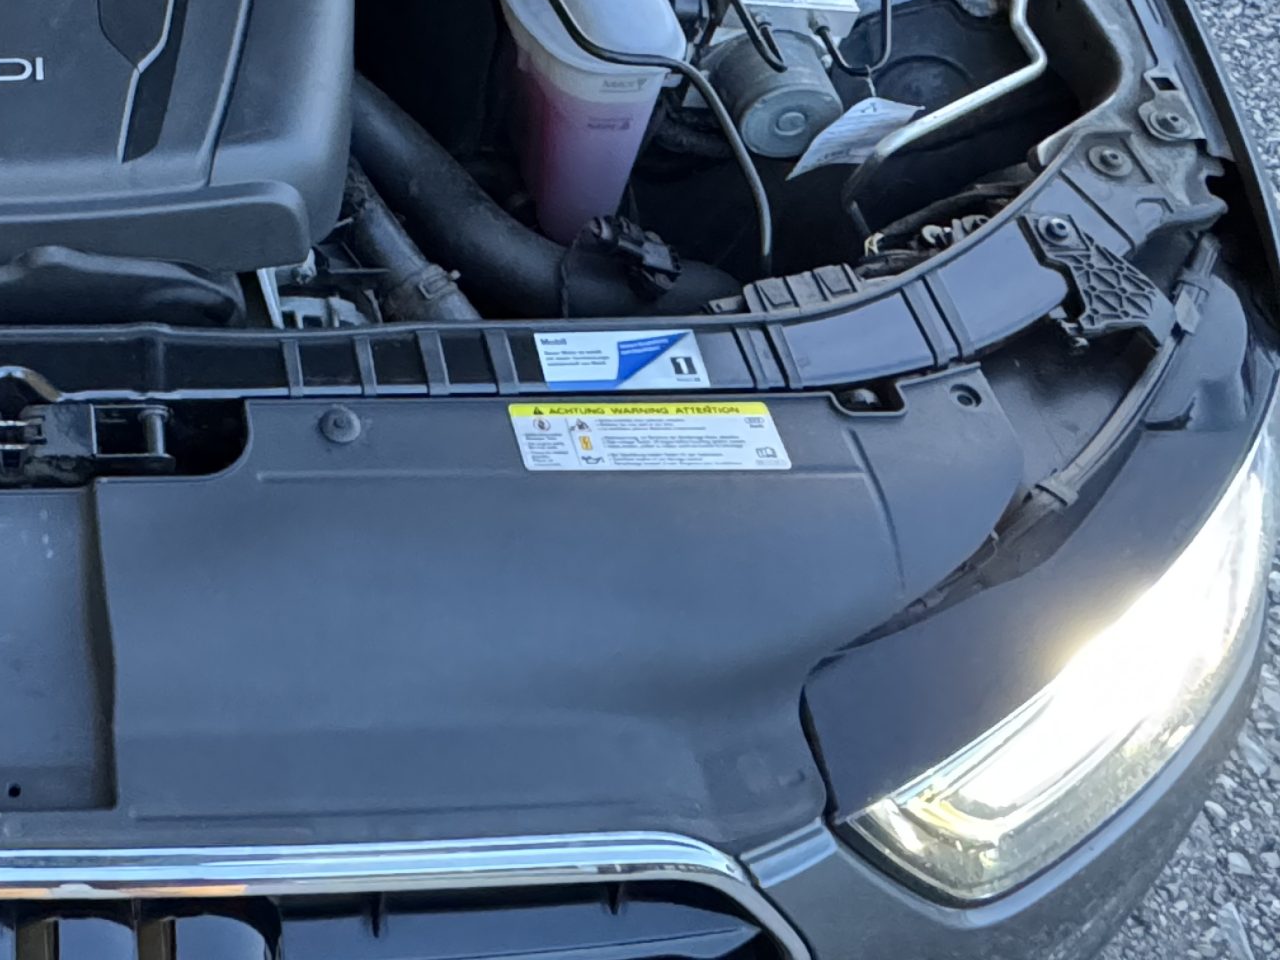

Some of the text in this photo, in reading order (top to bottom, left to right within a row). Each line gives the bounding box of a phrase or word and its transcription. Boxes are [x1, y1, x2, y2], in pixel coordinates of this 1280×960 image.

[674, 357, 691, 375] 1
[549, 407, 605, 415] ACHTUNG
[610, 407, 669, 415] WARNING
